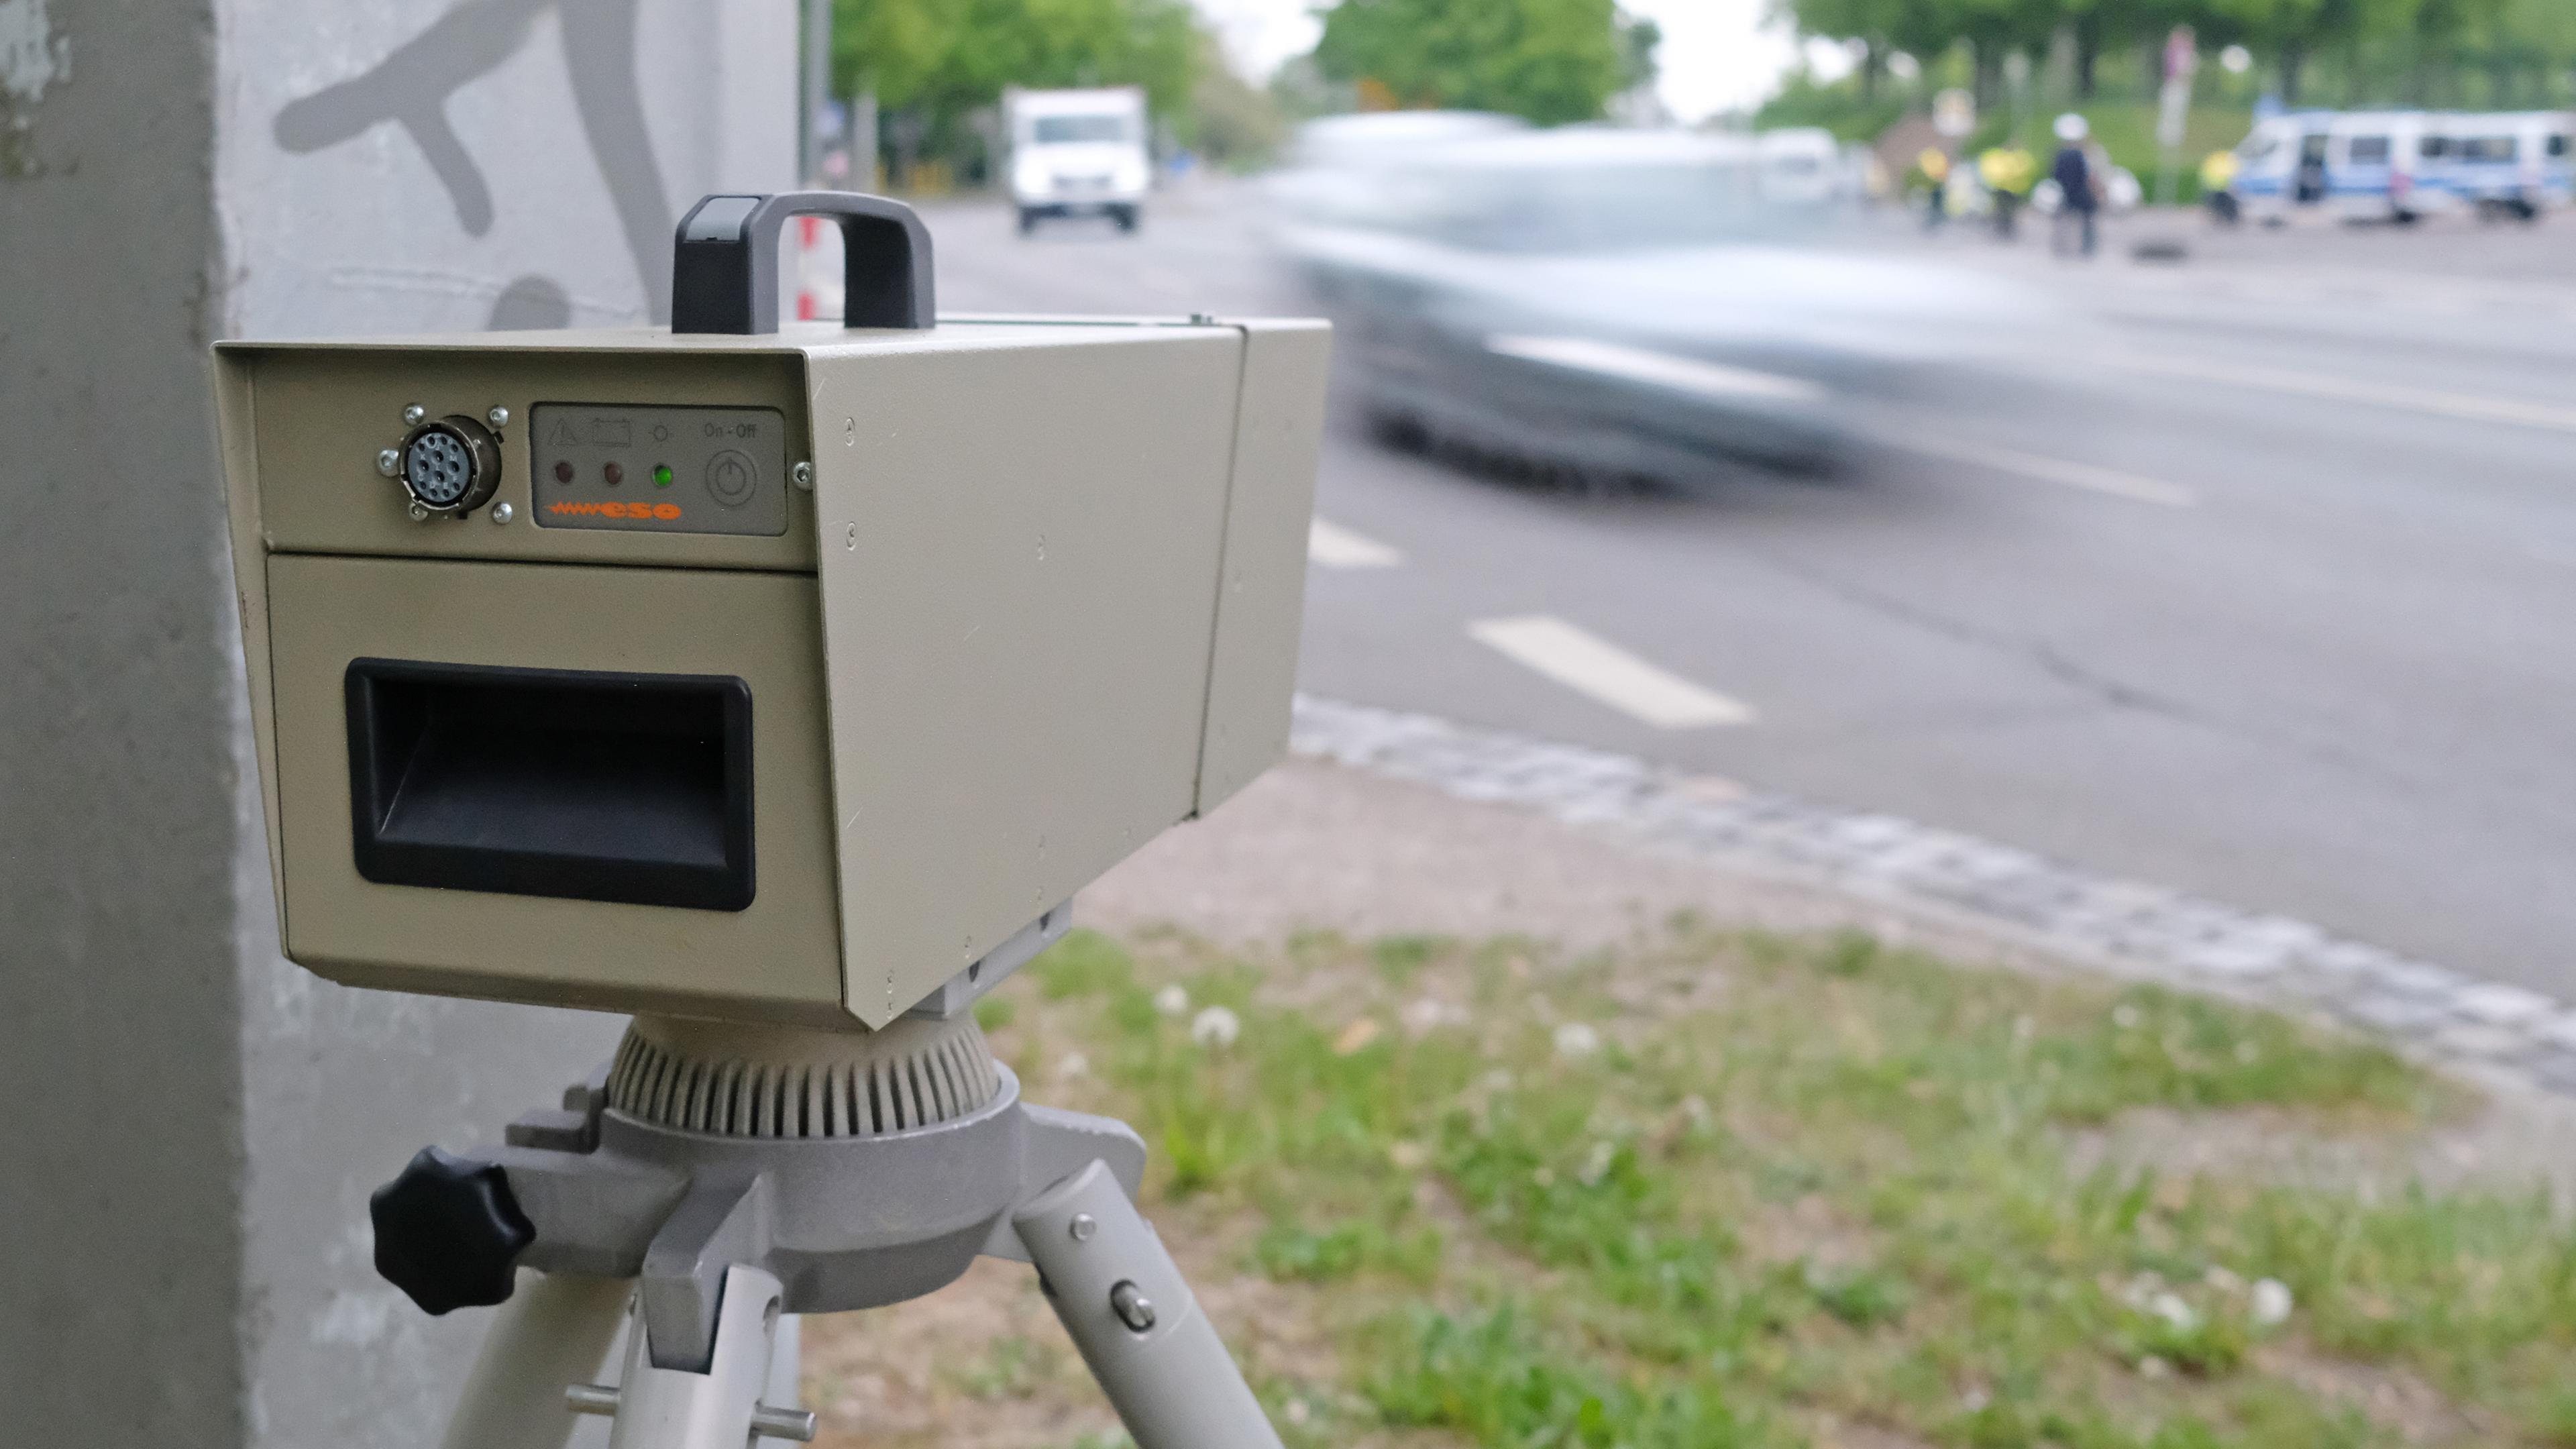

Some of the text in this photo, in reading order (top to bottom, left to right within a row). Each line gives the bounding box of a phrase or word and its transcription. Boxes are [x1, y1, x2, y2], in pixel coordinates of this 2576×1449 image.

[704, 423, 723, 437] On
[736, 423, 757, 438] Off
[600, 501, 682, 520] eso
